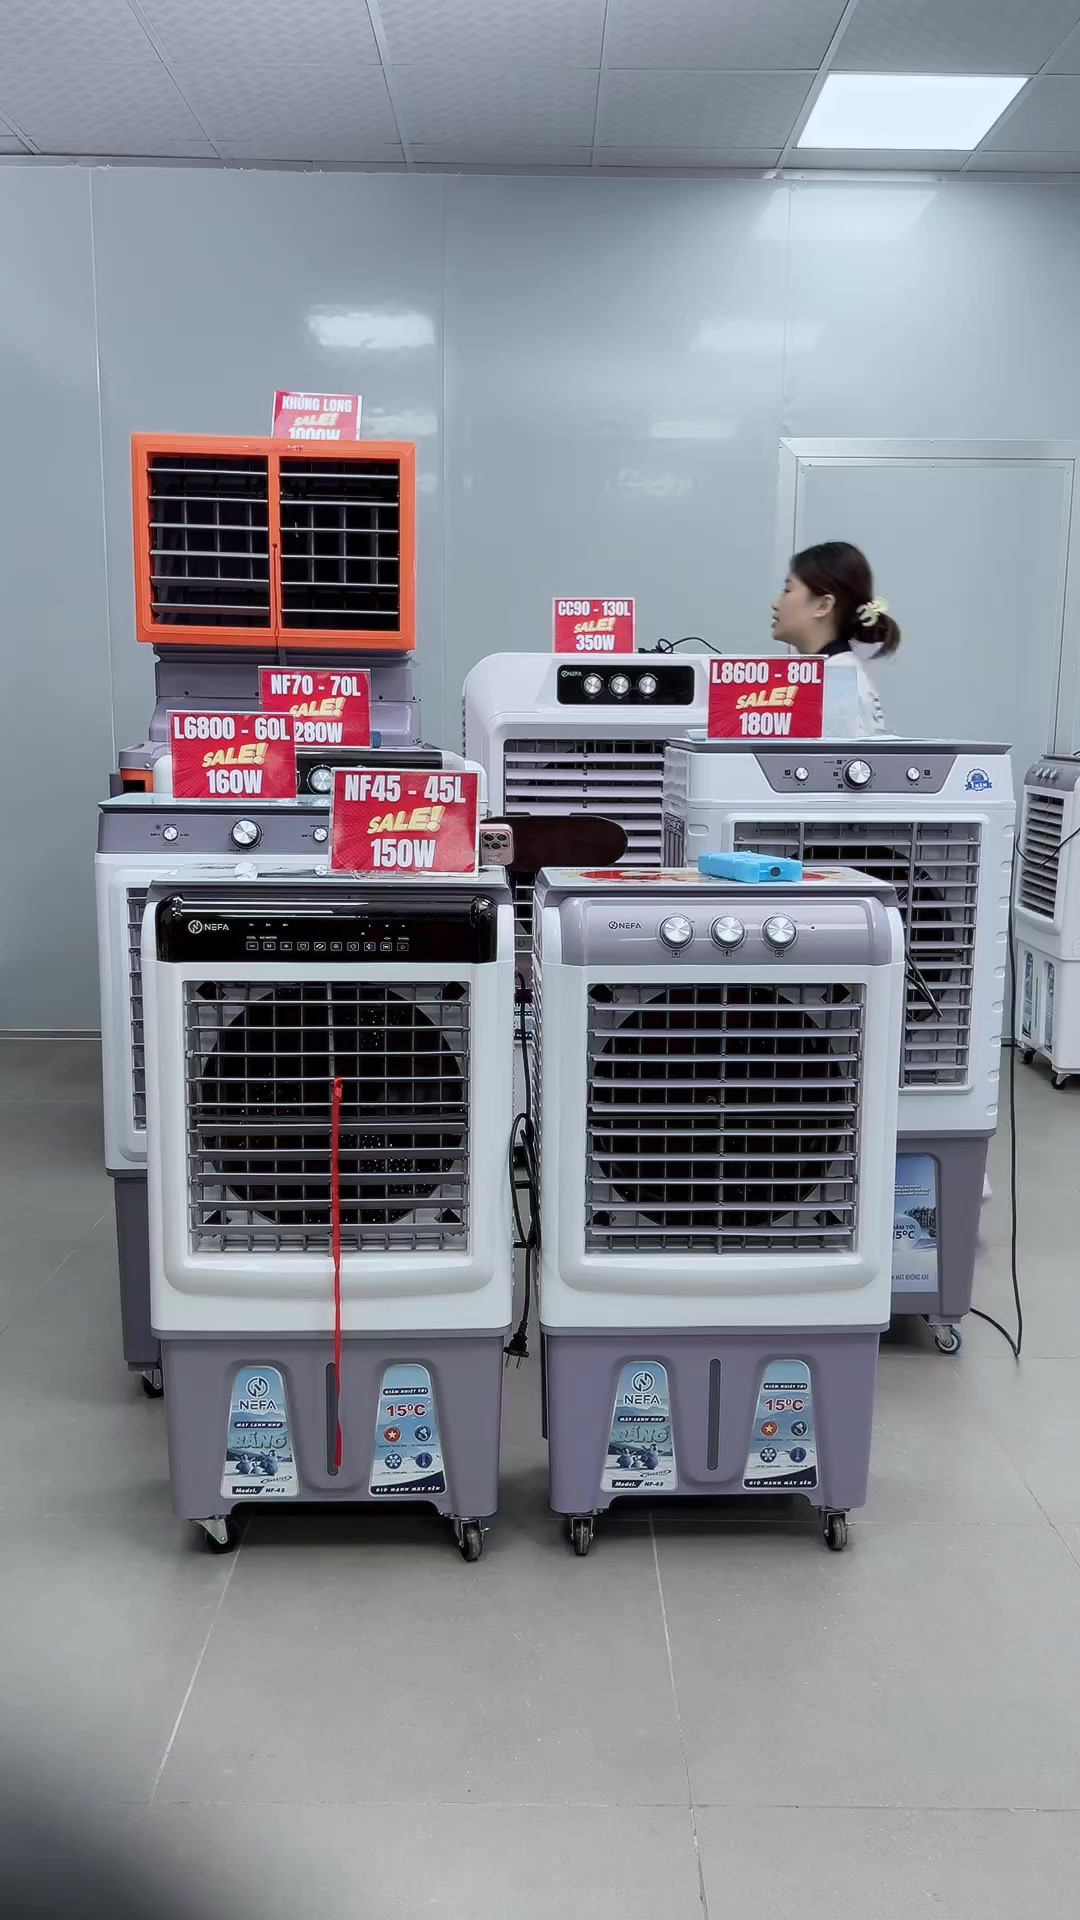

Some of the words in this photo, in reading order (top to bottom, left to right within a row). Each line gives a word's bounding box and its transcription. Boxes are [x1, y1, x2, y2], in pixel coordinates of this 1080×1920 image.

[323, 398, 352, 413] LONG
[293, 412, 340, 427] SALE!
[289, 427, 341, 440] 1000W
[558, 601, 590, 616] CC90
[602, 601, 631, 616] 130L
[573, 617, 617, 634] SALE!
[575, 634, 616, 651] 350W
[712, 662, 769, 684] L8600
[787, 662, 821, 684] 80L
[270, 674, 314, 696] NF70
[330, 675, 361, 697] 70L
[289, 697, 347, 718] SALE!
[735, 685, 799, 710] SALE!
[174, 717, 236, 740] L6800
[254, 718, 290, 741] 60L
[294, 721, 343, 743] 280W
[739, 712, 792, 736] 180W
[201, 742, 269, 768] SALE!
[206, 769, 263, 795] 160W
[344, 774, 401, 802] NF45
[423, 776, 466, 804] 45L
[366, 805, 446, 835] SALE!
[370, 838, 436, 868] 150W
[204, 923, 230, 931] NEFA
[618, 922, 642, 930] NEFA
[239, 1399, 277, 1411] NEFA
[623, 1394, 660, 1405] NEFA
[231, 1430, 288, 1449] BĂNG
[614, 1424, 669, 1443] BĂNG
